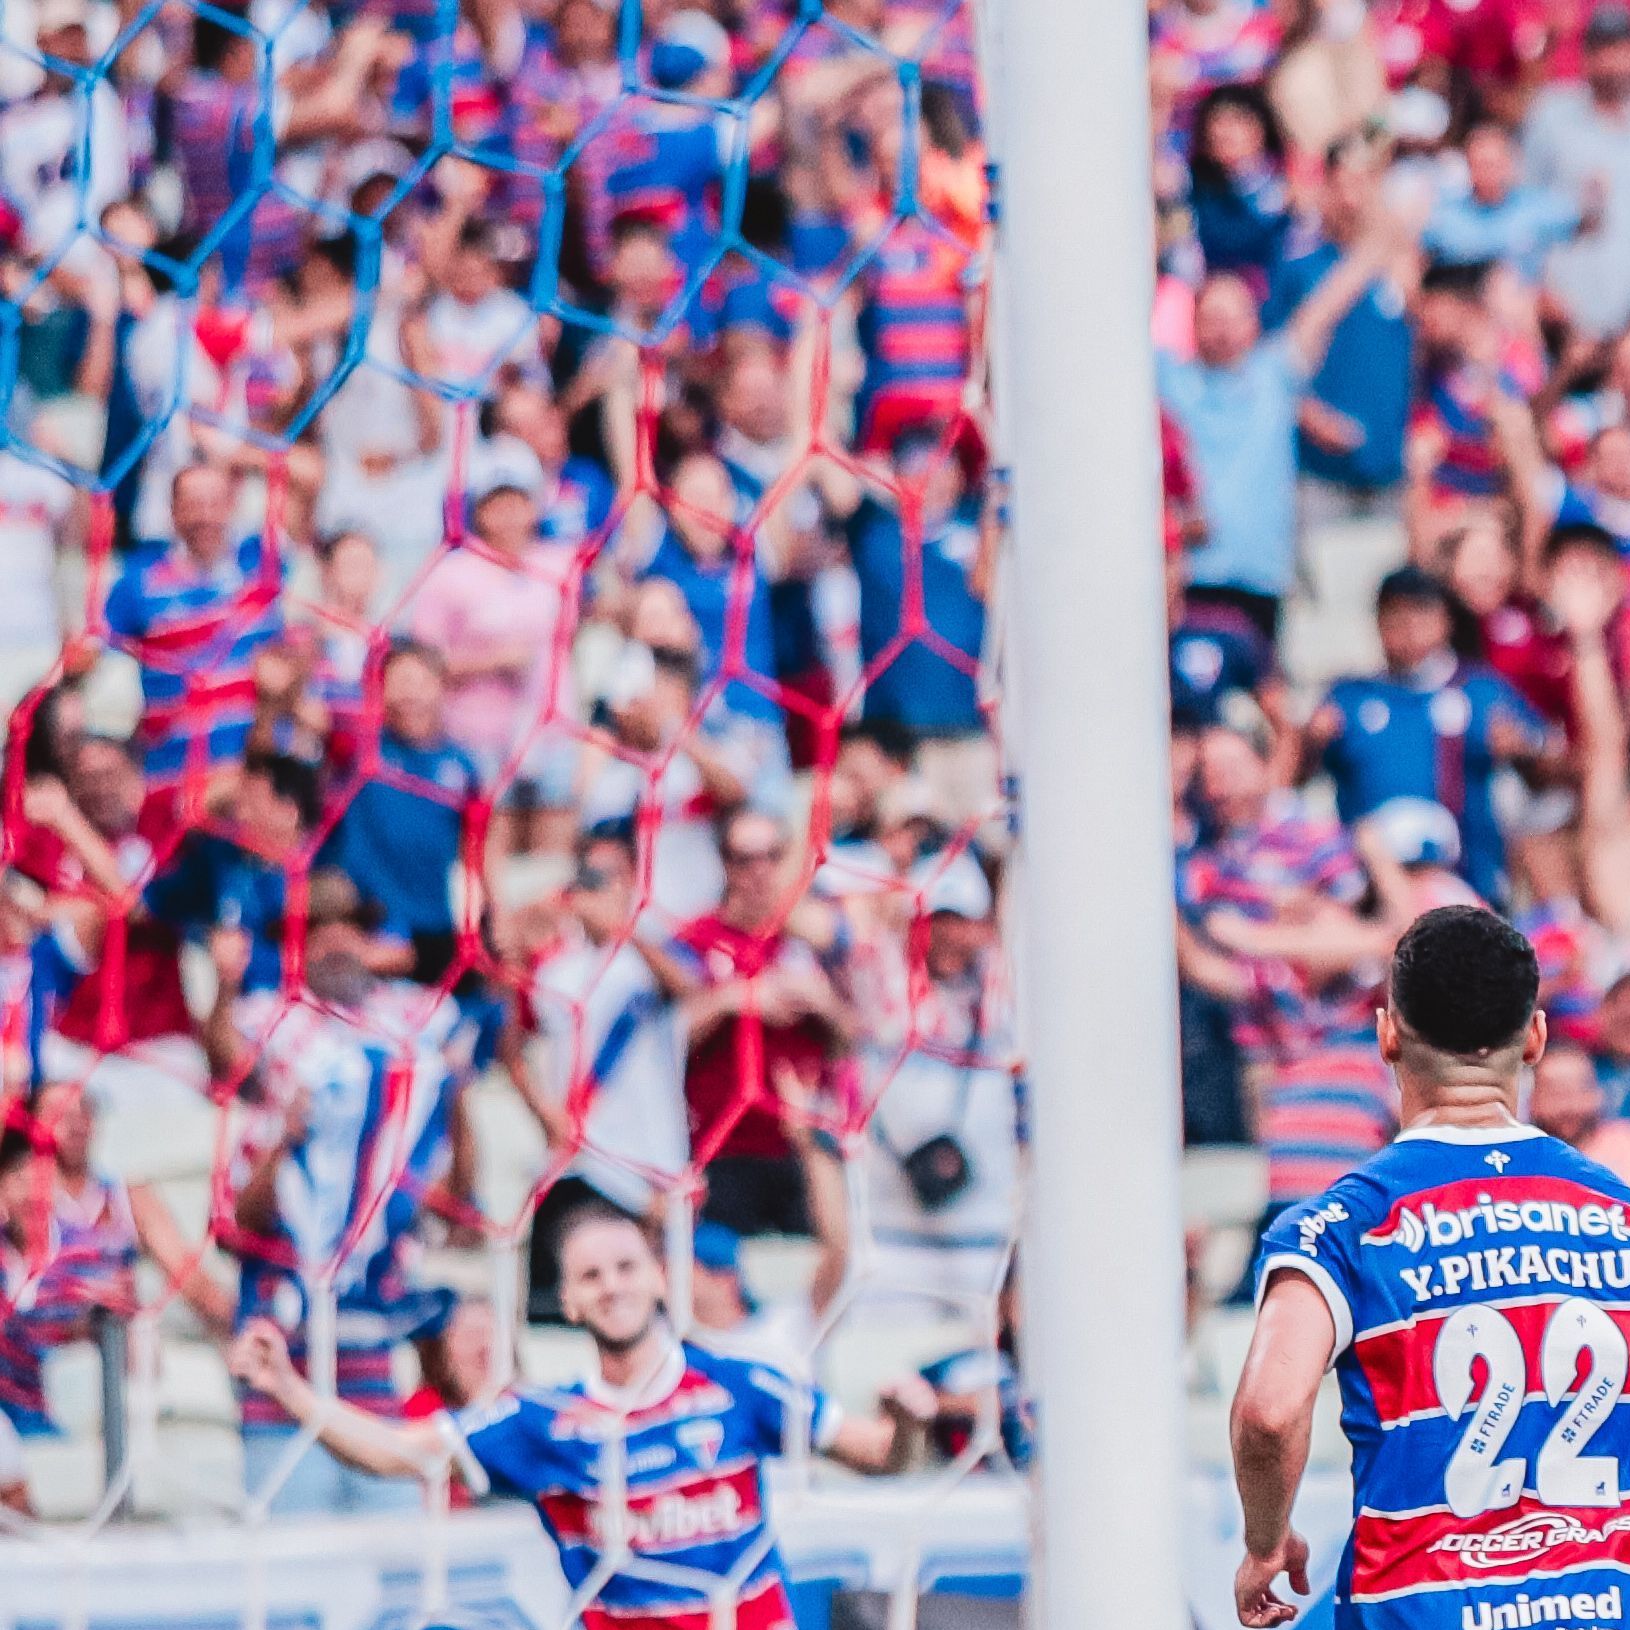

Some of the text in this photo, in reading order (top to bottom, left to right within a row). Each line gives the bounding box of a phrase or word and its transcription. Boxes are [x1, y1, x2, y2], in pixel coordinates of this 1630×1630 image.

[1422, 1193, 1627, 1248] brisanet
[1434, 1297, 1630, 1519] 22
[1479, 1382, 1516, 1438] FTRADE
[1573, 1376, 1616, 1429] FTRADE
